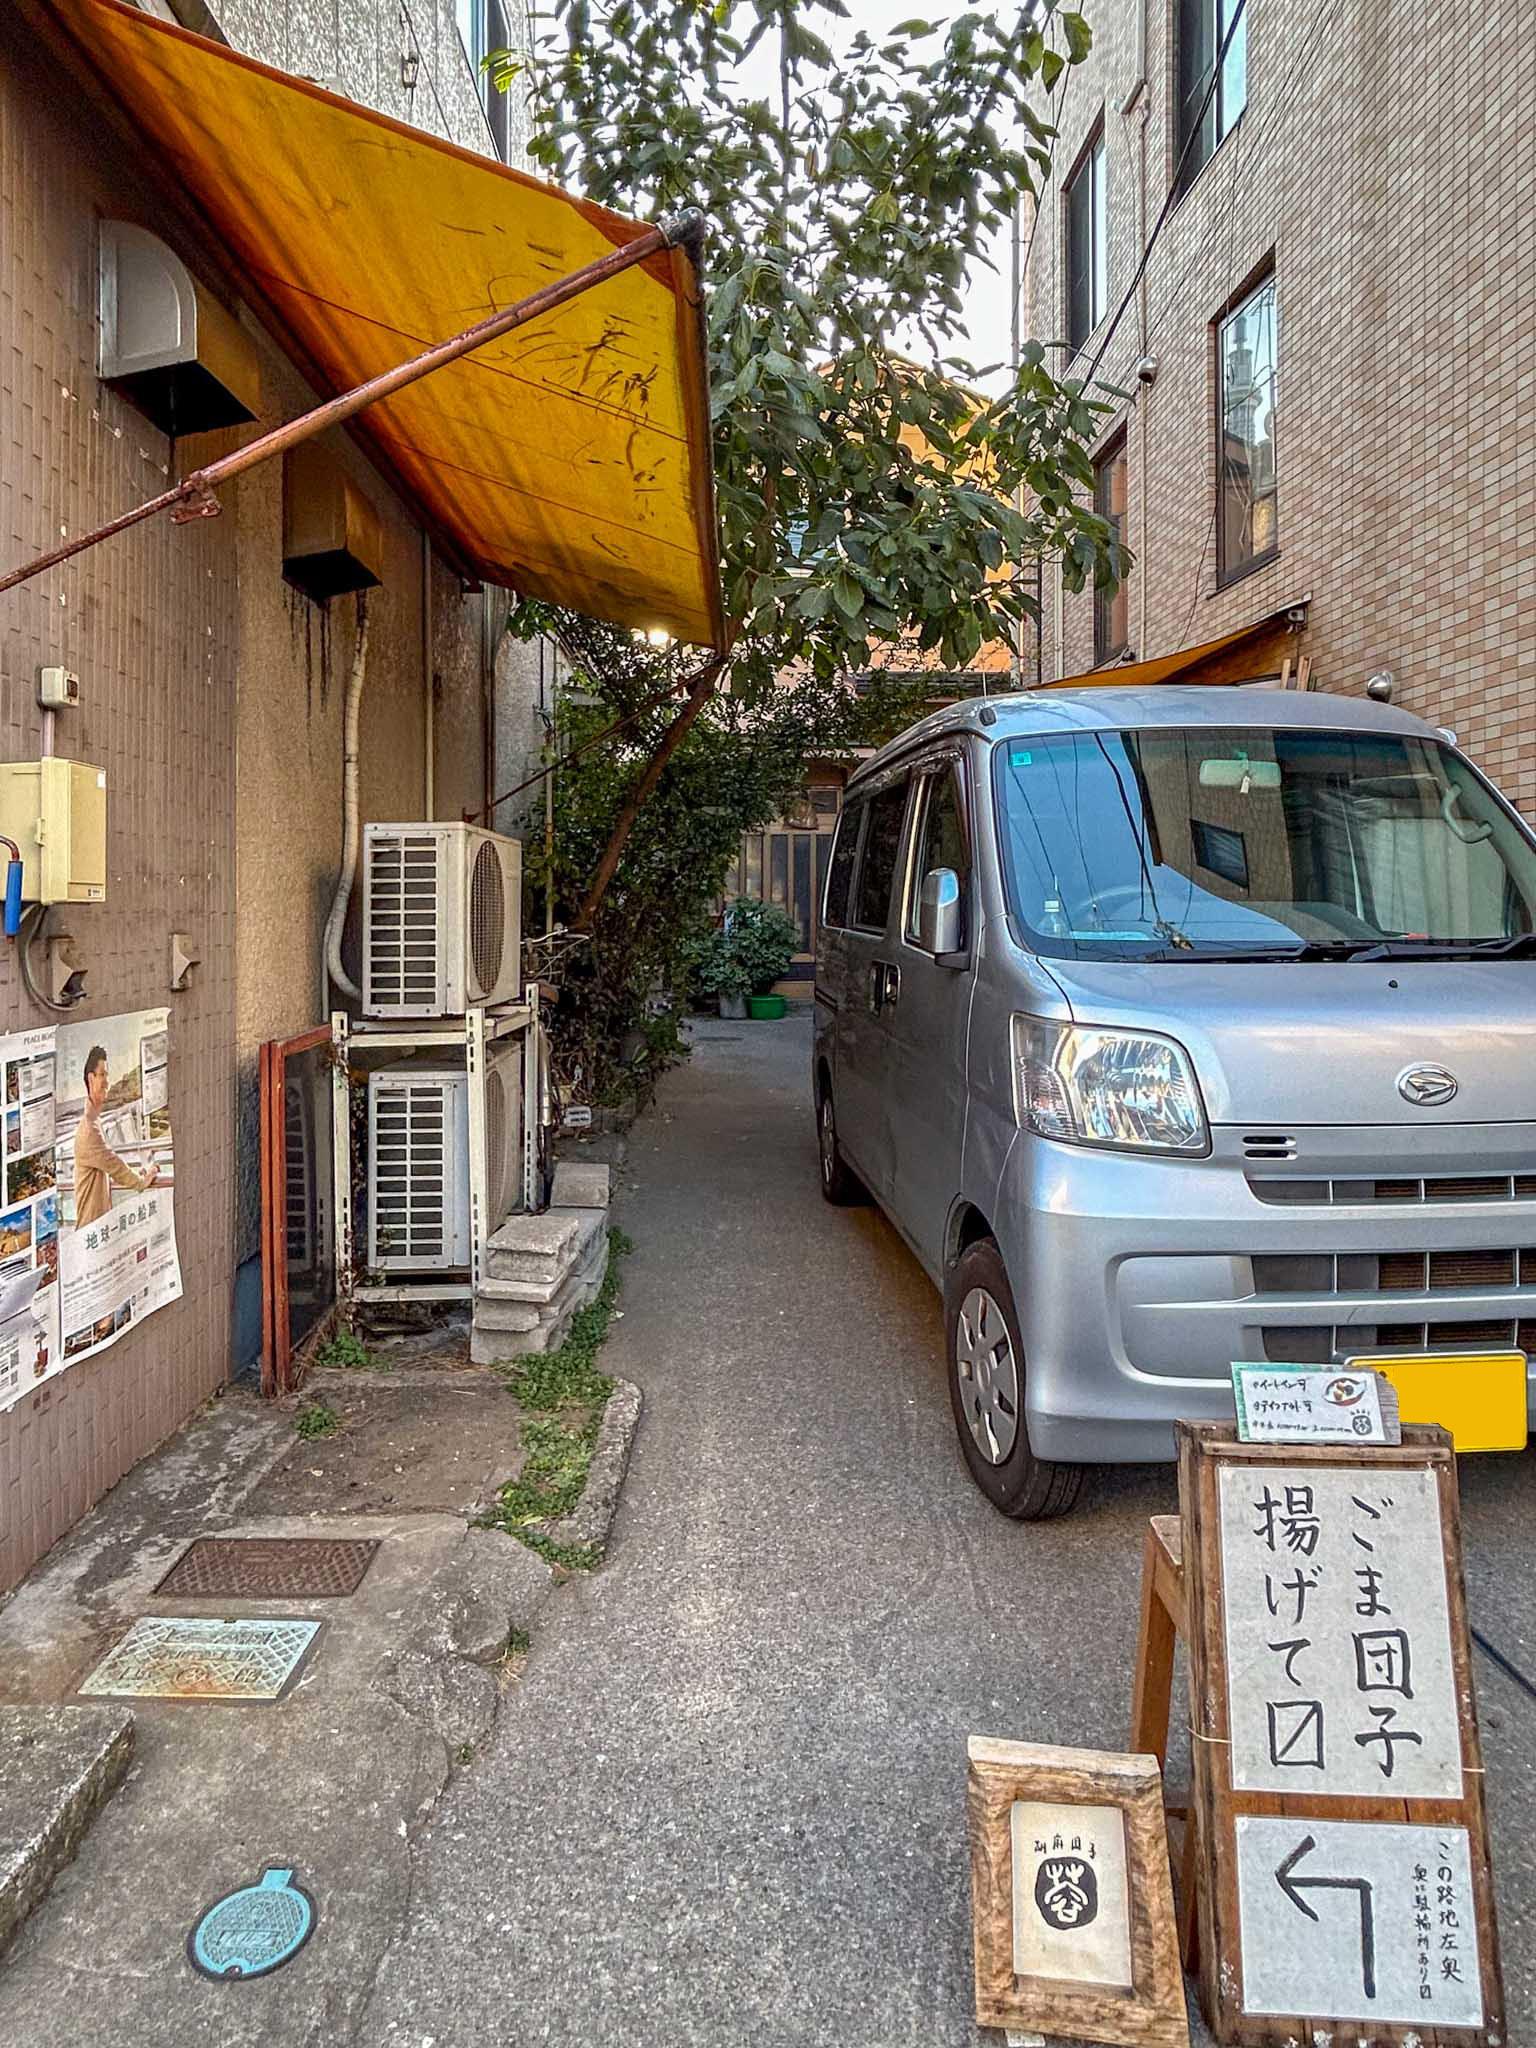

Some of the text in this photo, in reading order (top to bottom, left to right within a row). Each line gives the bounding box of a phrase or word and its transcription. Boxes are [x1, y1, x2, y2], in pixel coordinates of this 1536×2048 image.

[85, 1200, 158, 1250] 地球一周の船旅
[1351, 1494, 1422, 1777] ごま団子
[1437, 1841, 1464, 1984] この路地左奥
